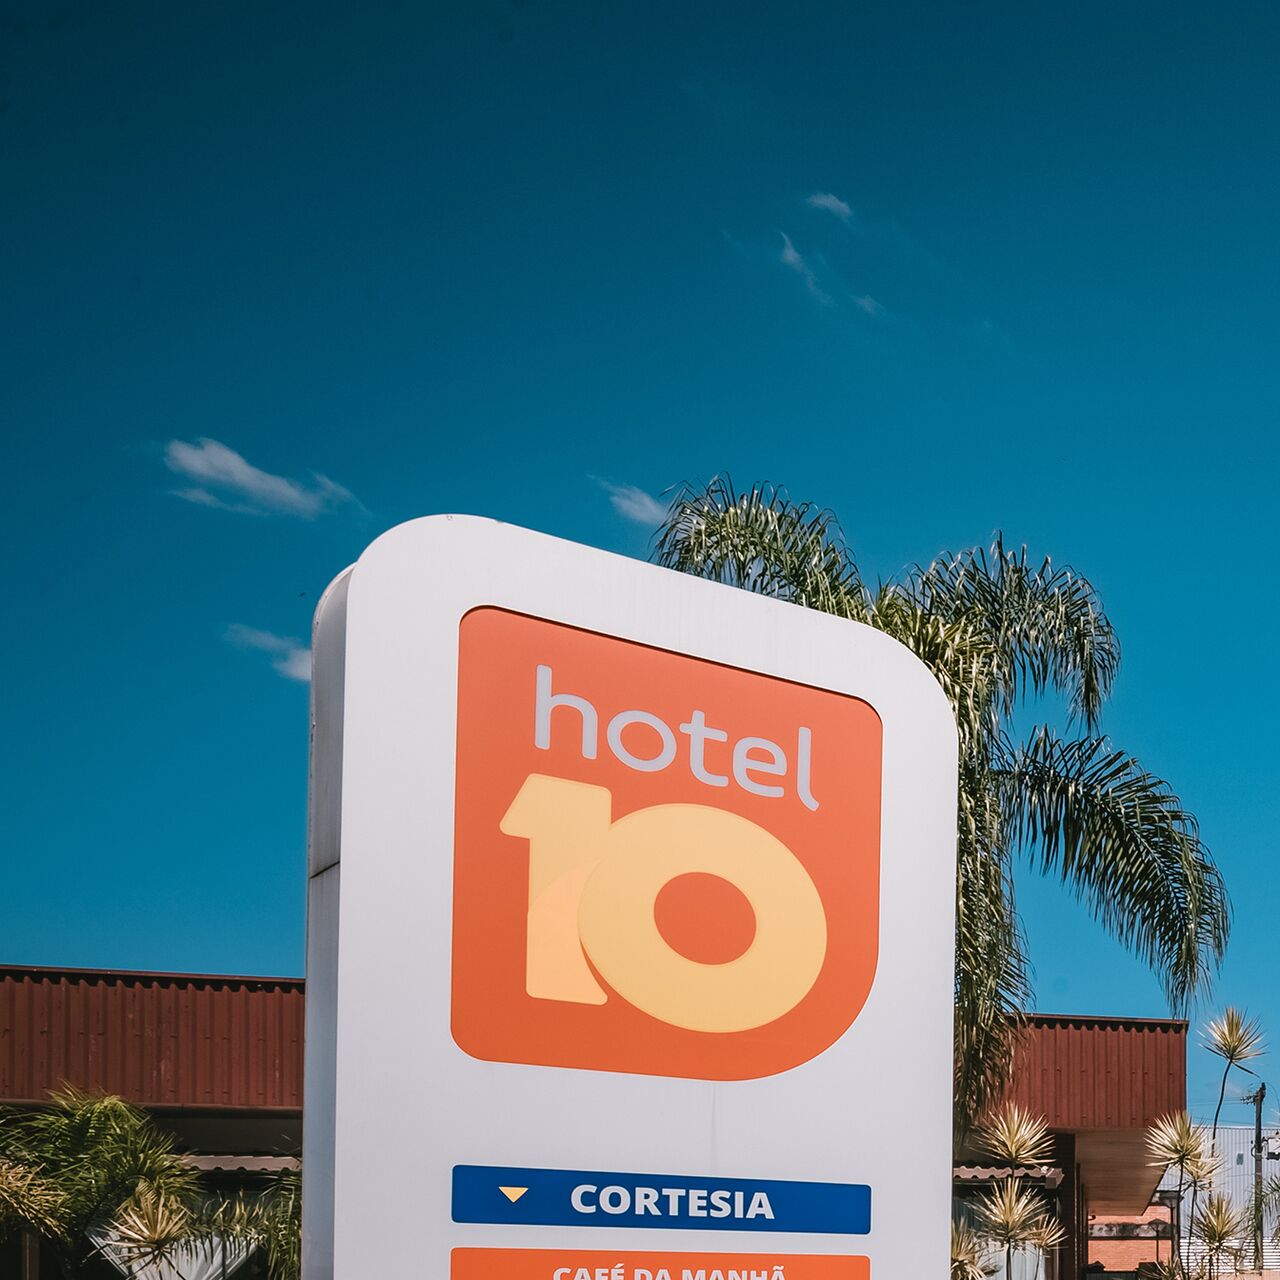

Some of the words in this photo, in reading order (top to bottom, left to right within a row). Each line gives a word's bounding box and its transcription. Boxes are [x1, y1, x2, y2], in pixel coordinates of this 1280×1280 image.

[534, 664, 820, 811] hotel
[499, 773, 828, 1033] 10
[570, 1183, 775, 1220] CORTESIA
